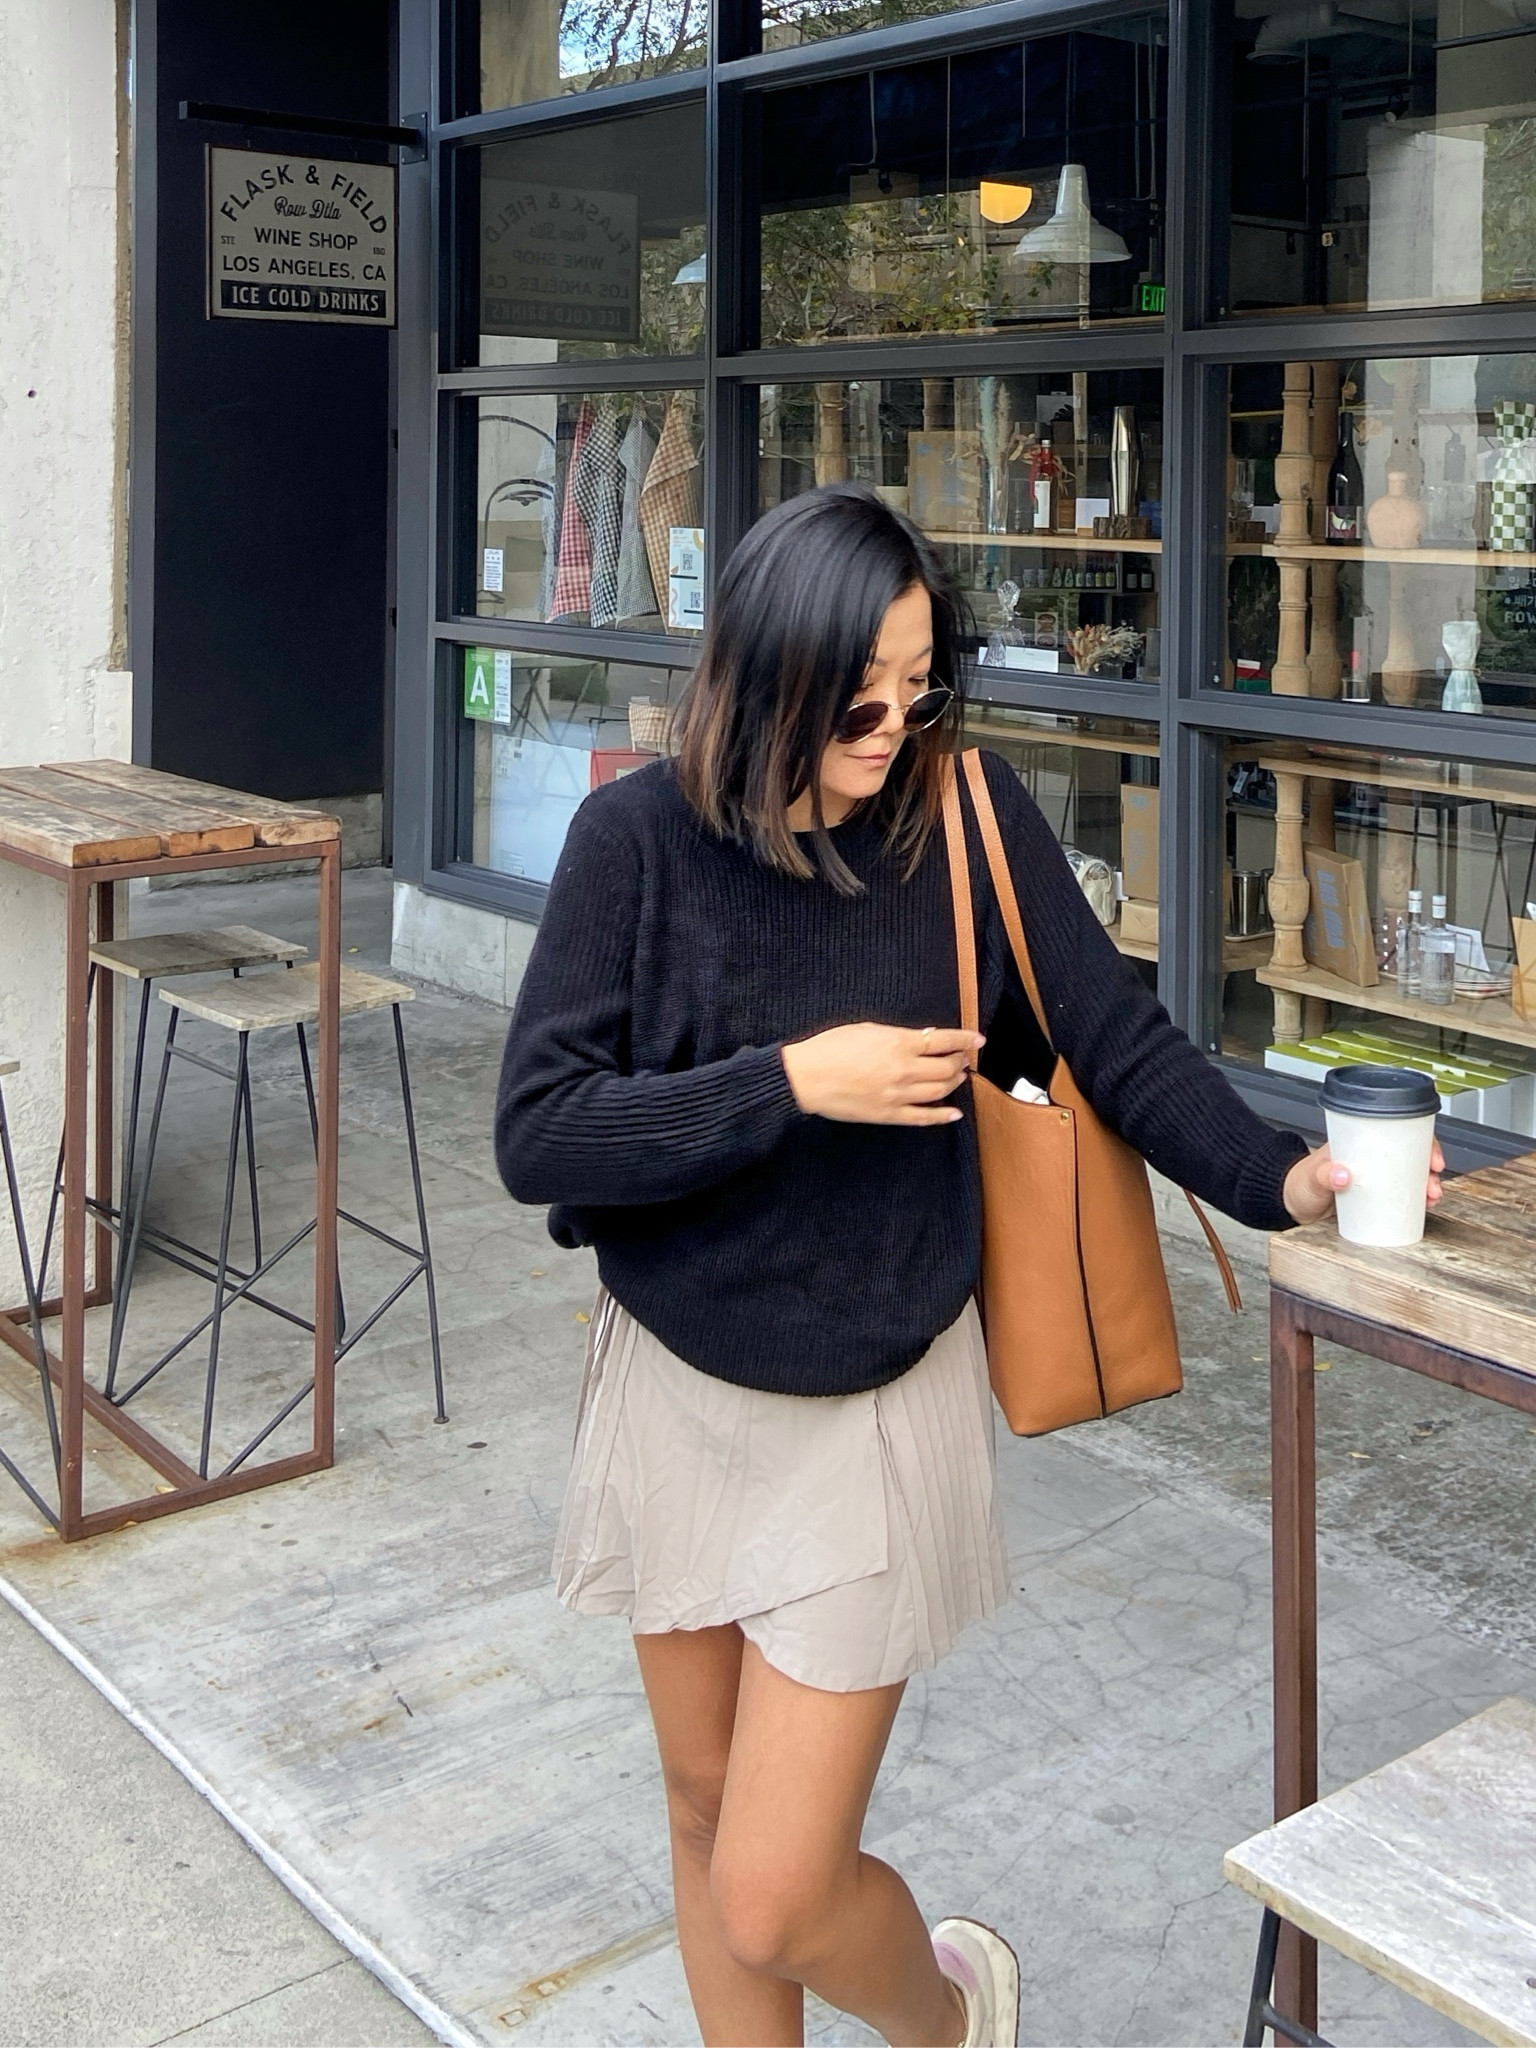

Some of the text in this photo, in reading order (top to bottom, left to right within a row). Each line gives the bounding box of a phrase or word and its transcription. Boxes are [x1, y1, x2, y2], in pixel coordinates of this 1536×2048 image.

[220, 164, 387, 234] FLASK & FIELD
[274, 196, 307, 218] Row
[220, 235, 236, 246] STE
[254, 227, 358, 251] WINE SHOP
[222, 255, 387, 281] LOS ANGELES, CA
[231, 286, 380, 312] ICE COLD DRINKS
[1142, 285, 1166, 313] EXIT
[469, 665, 490, 705] A
